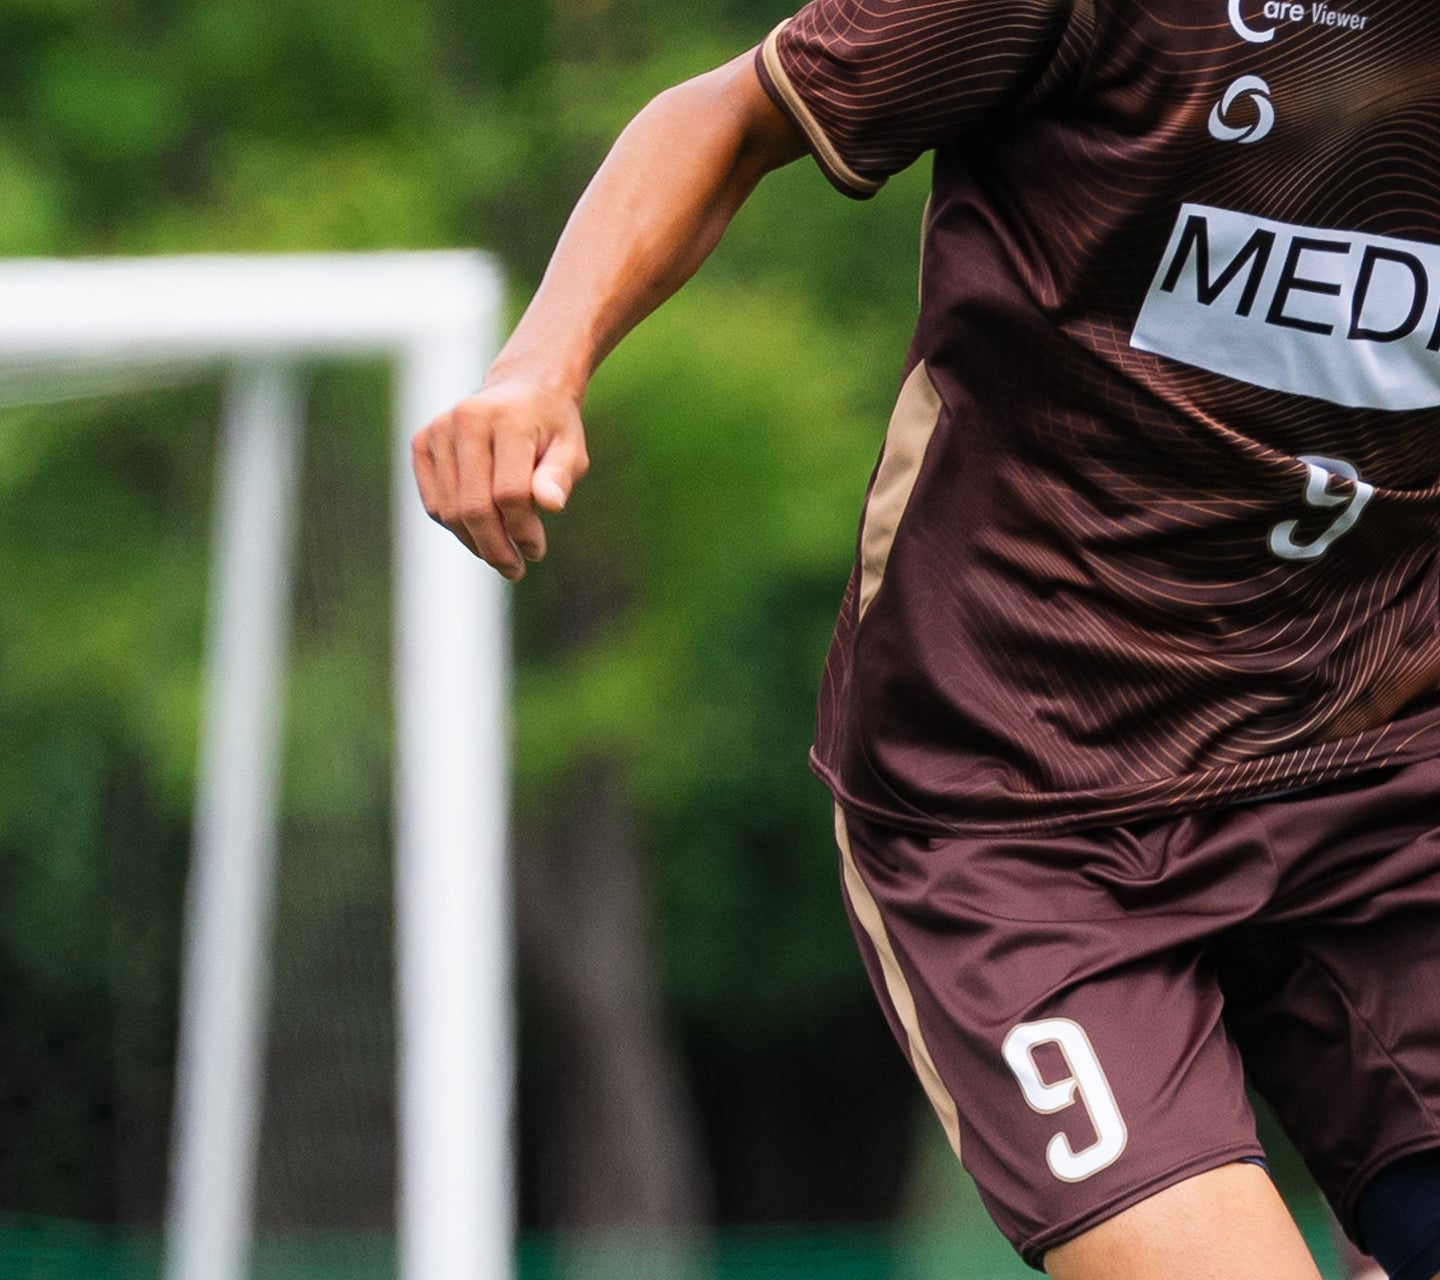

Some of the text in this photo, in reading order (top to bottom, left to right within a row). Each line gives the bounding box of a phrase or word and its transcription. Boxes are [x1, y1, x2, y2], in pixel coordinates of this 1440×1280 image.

[1312, 2, 1369, 30] Viewer
[1271, 455, 1374, 559] 9
[1001, 1017, 1128, 1183] 9
